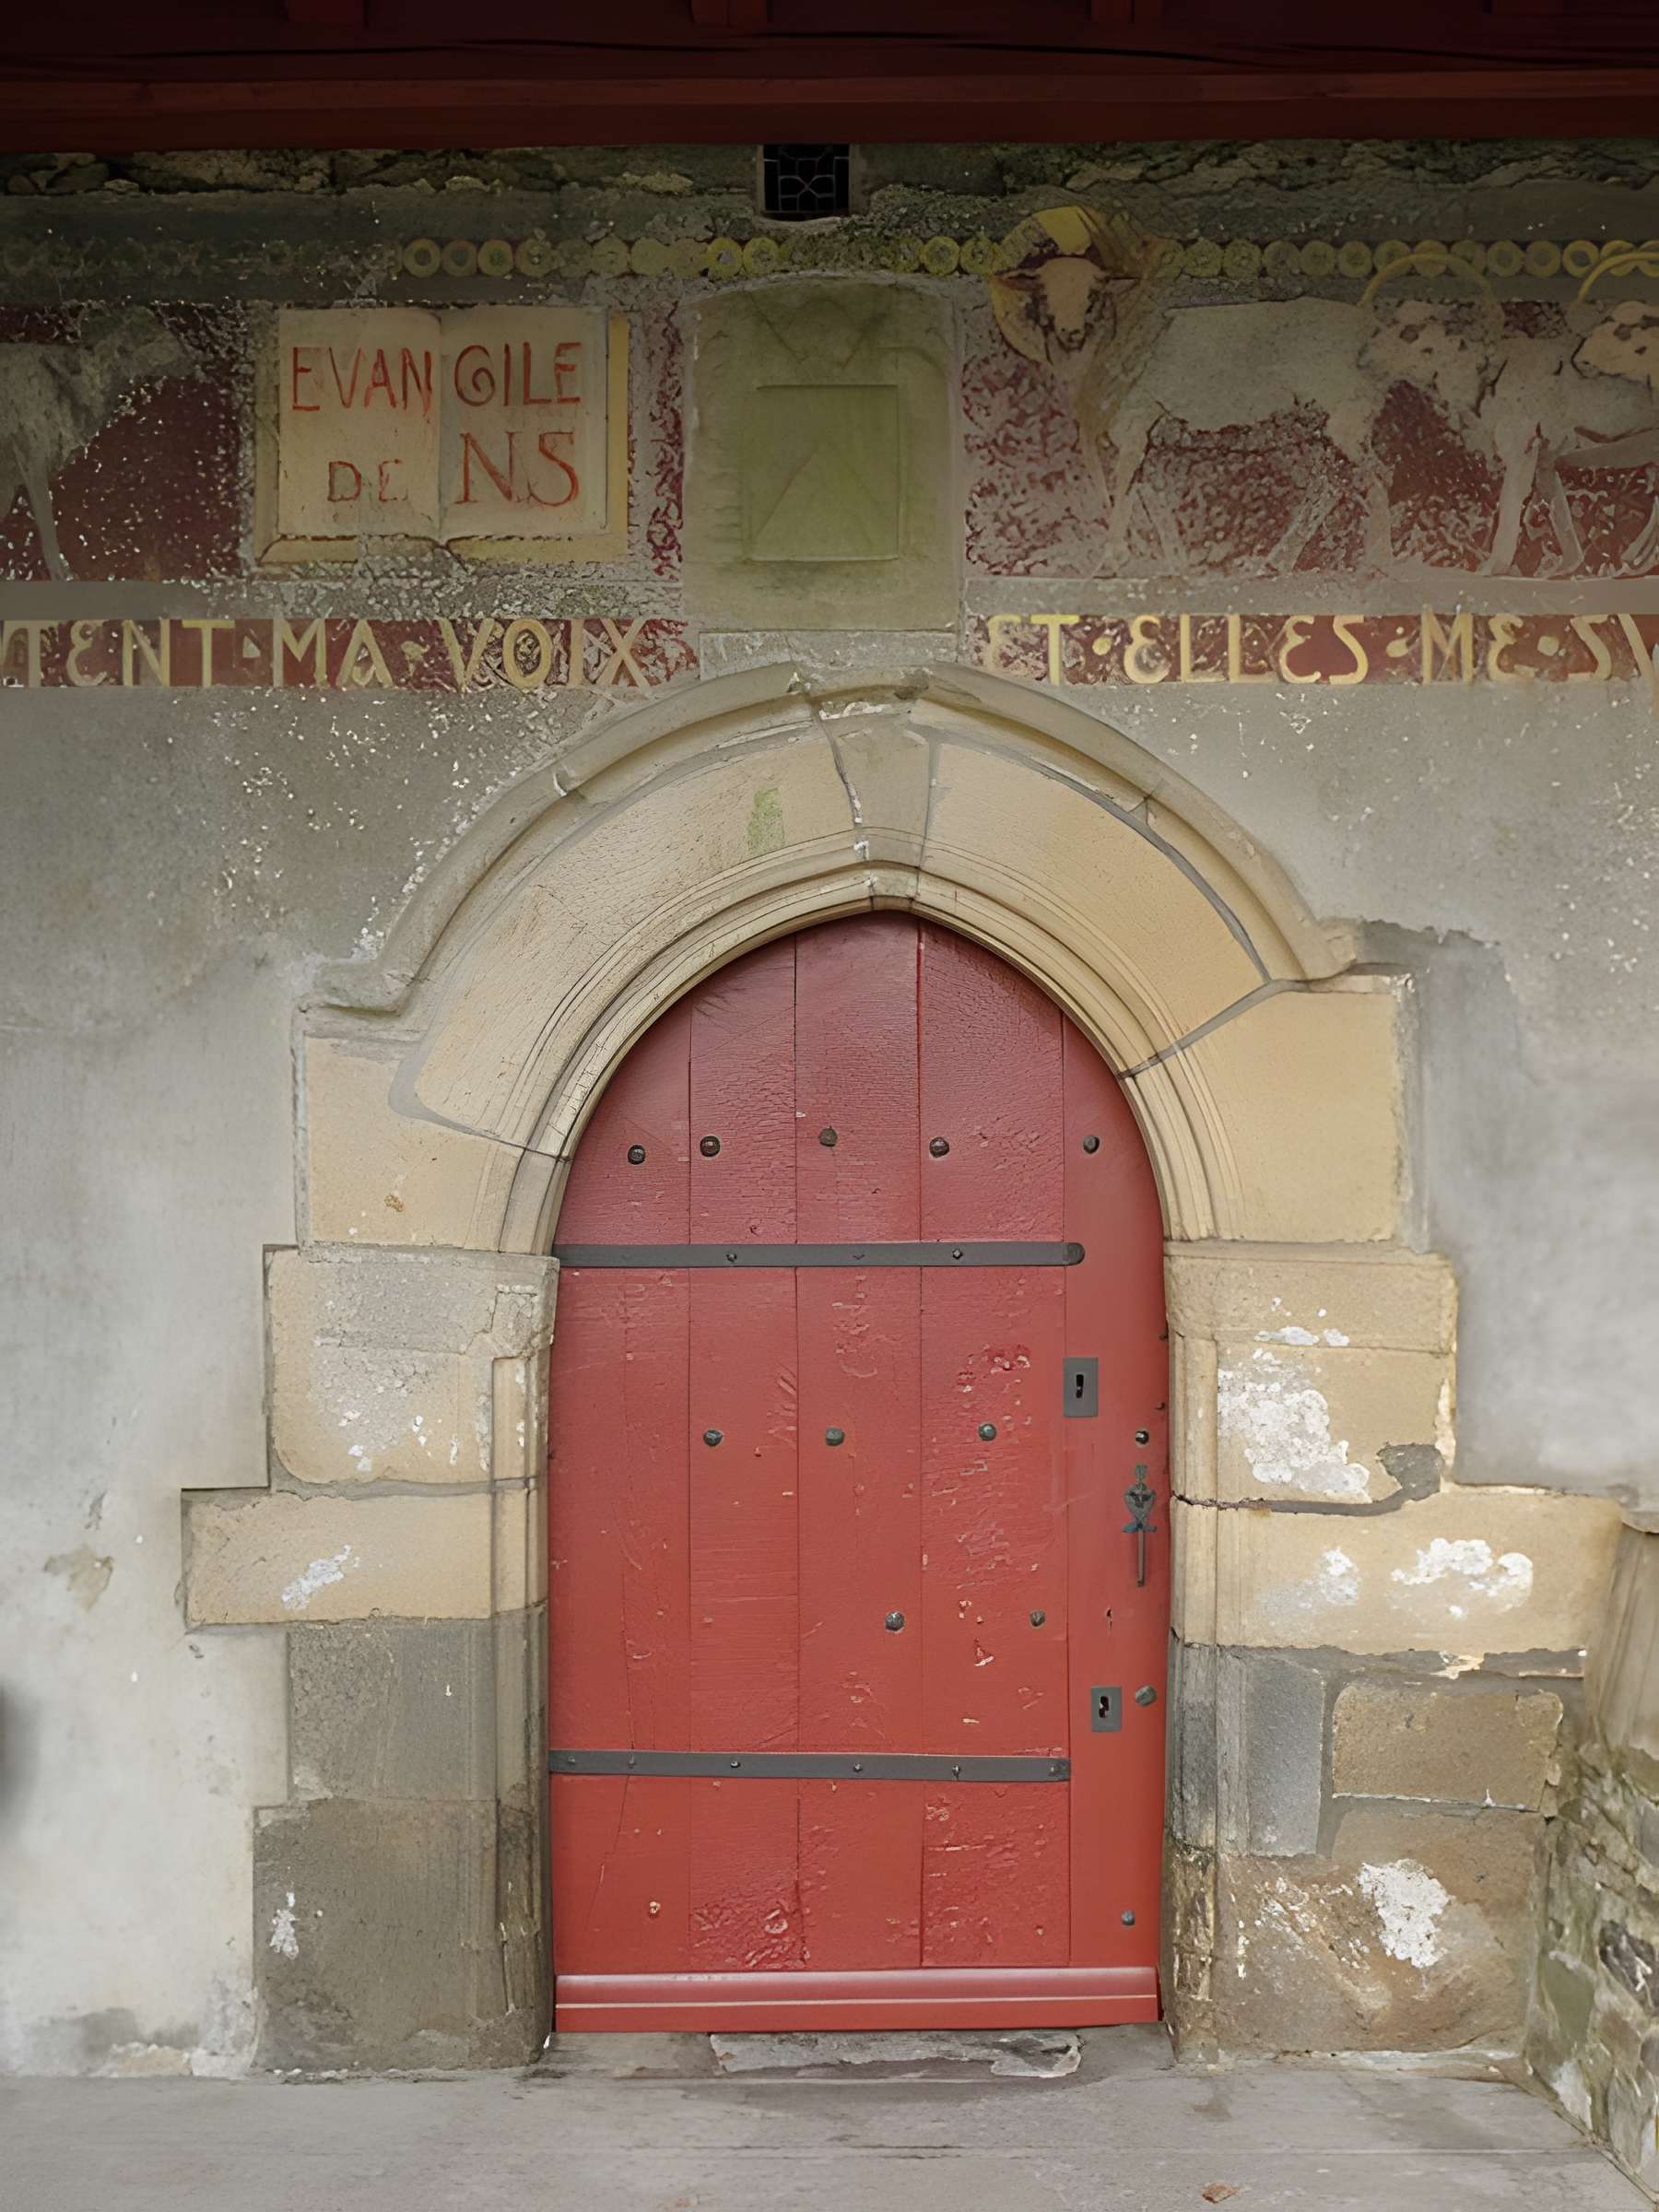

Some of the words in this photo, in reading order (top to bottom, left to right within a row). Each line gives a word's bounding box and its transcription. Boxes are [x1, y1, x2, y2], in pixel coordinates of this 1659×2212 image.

[326, 458, 407, 502] DE
[273, 617, 394, 689] MA
[437, 617, 652, 690] VOIX
[987, 614, 1081, 685] ET
[1123, 613, 1370, 685] ELLES
[1420, 608, 1535, 685] ME
